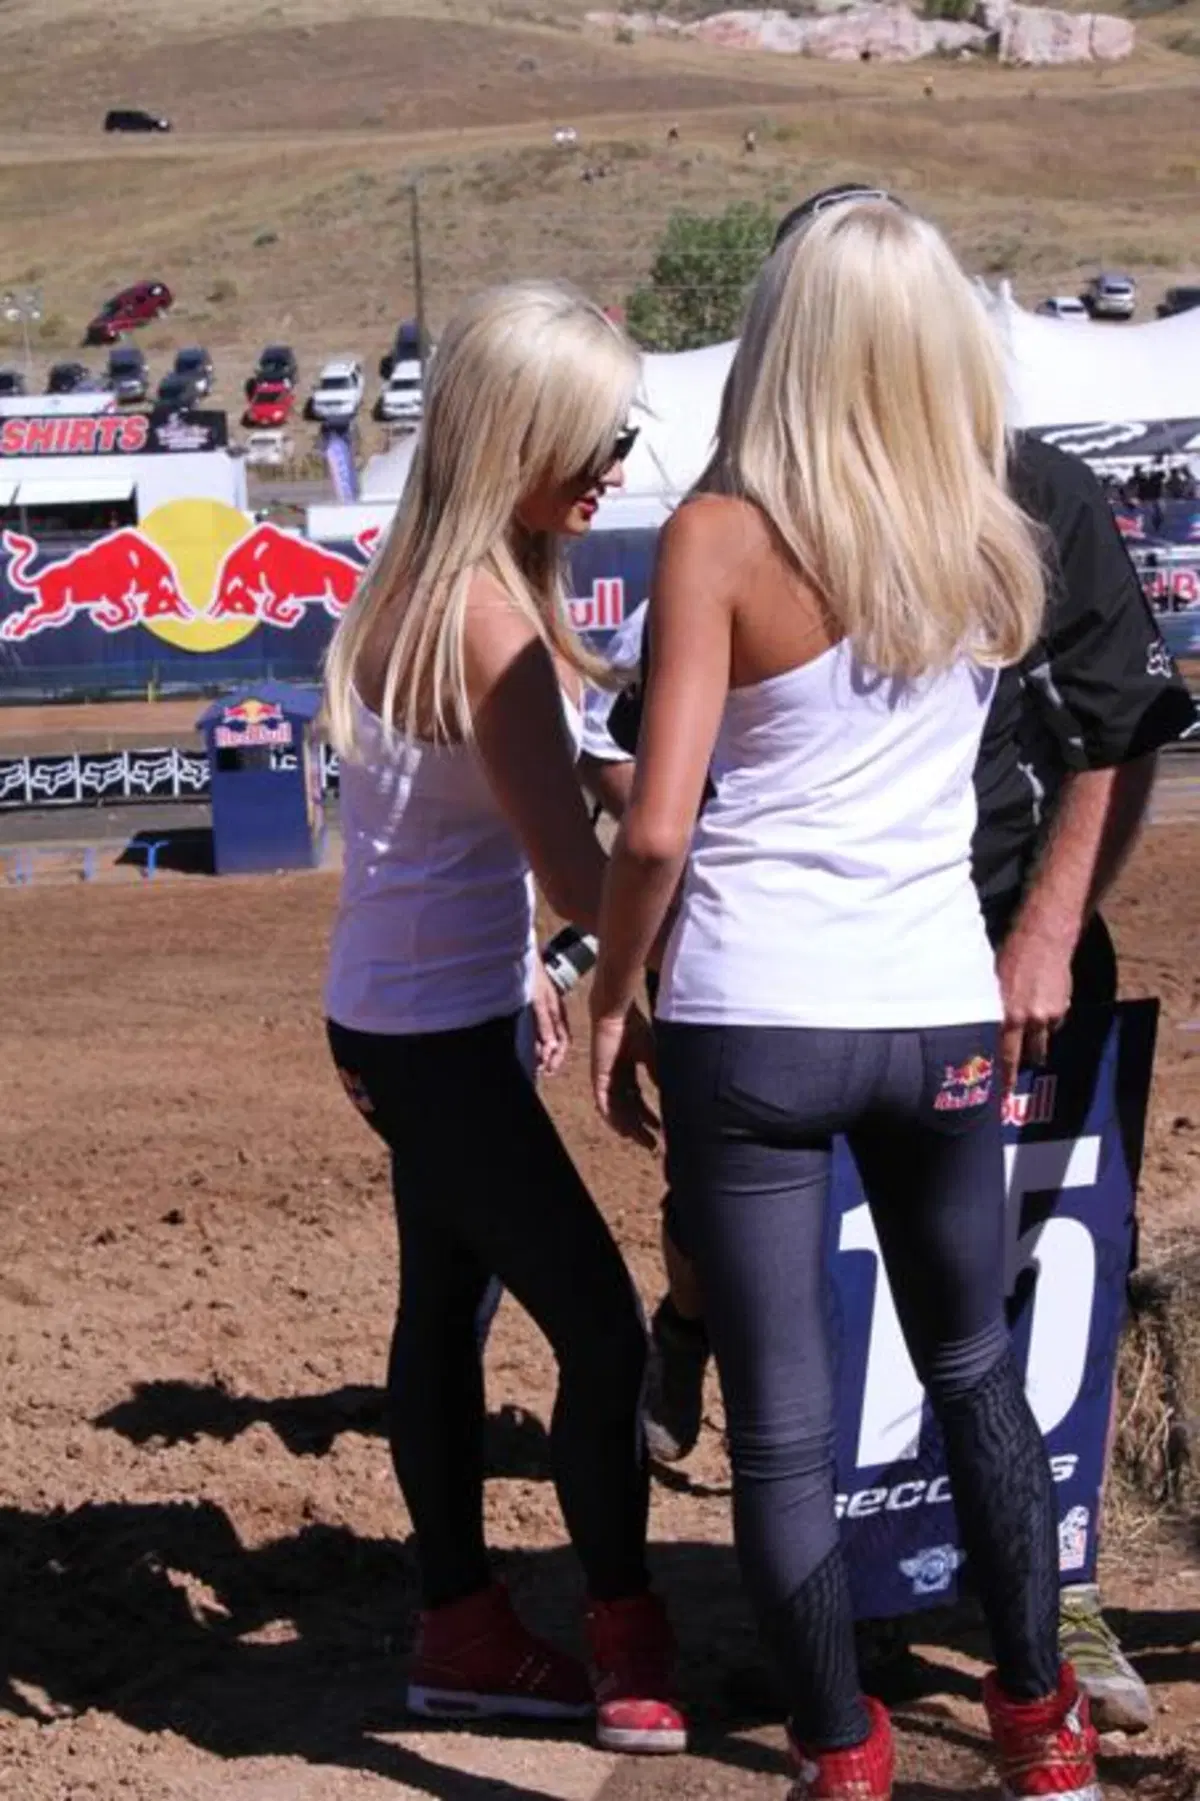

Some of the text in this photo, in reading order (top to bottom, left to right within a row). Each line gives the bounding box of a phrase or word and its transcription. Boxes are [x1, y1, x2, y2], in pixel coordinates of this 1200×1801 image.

[1, 415, 149, 454] SHIRTS
[564, 578, 624, 631] ull
[839, 1136, 1102, 1468] 15
